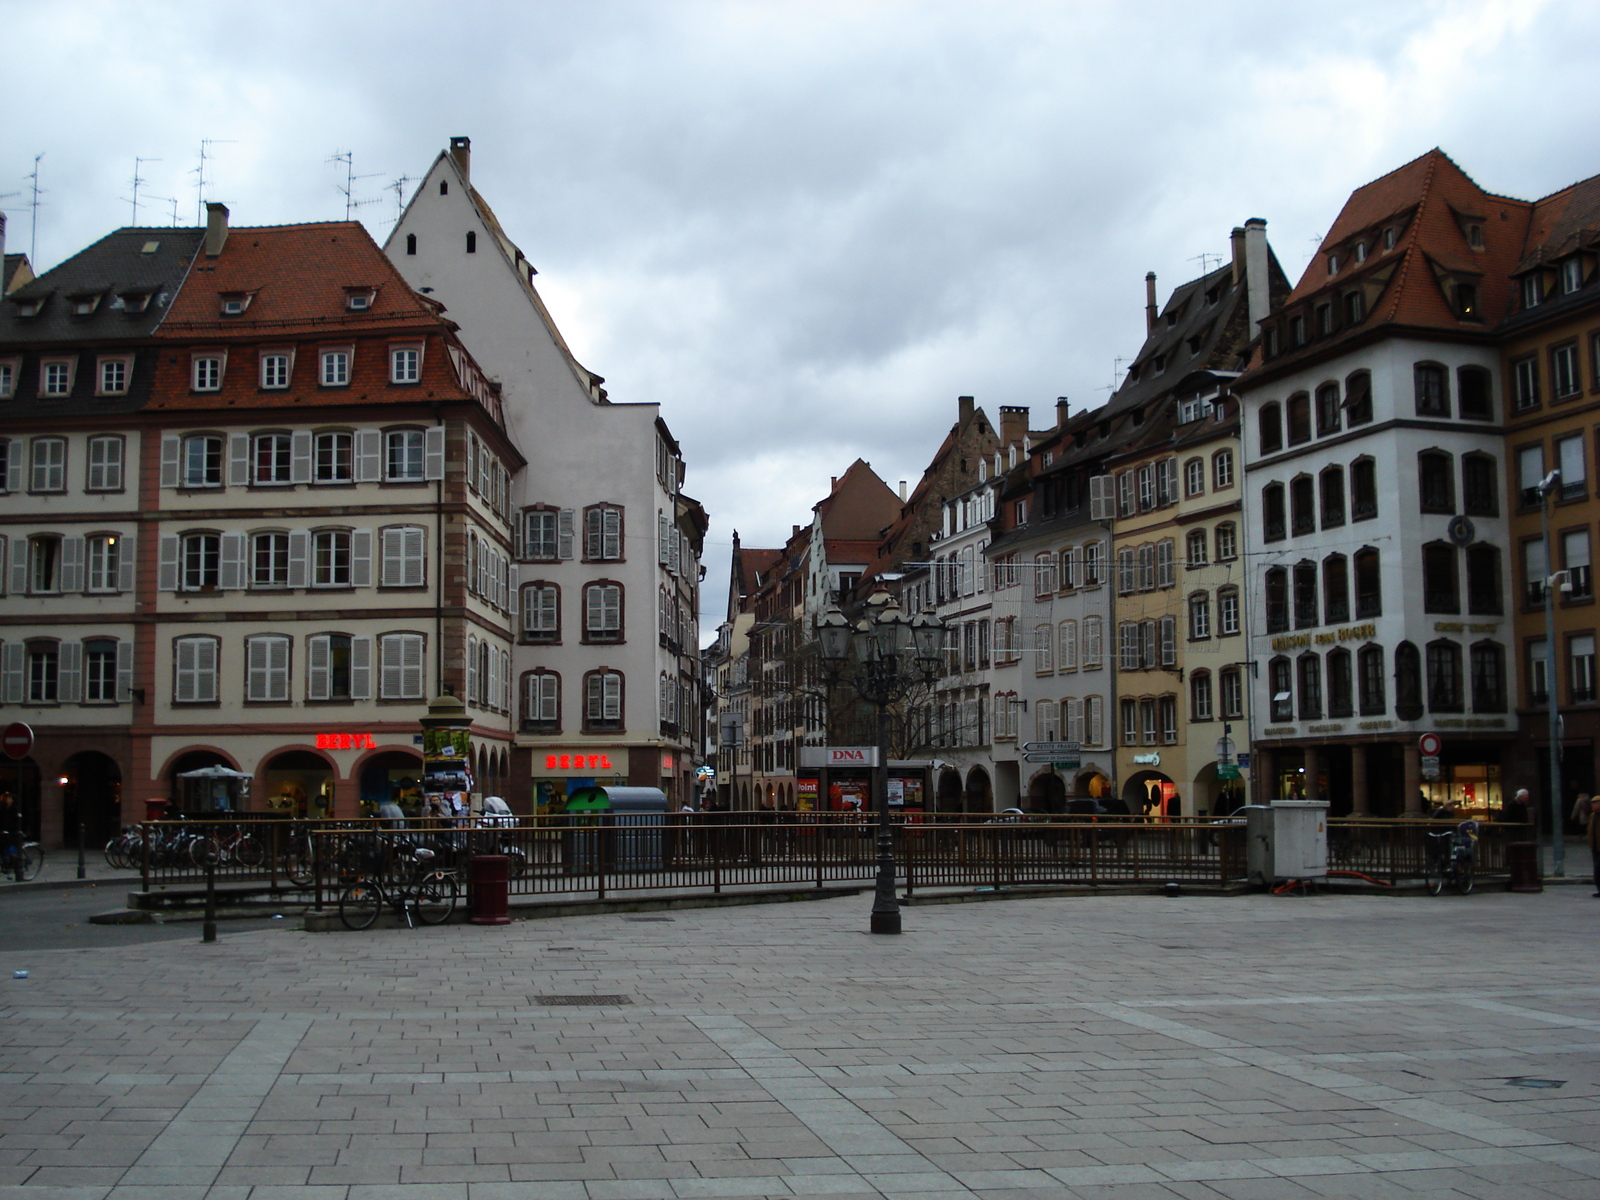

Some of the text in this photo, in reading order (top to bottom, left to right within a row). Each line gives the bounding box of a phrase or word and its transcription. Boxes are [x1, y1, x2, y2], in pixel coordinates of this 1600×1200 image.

[316, 733, 376, 749] BERYL
[545, 754, 612, 769] BERYL
[832, 750, 864, 760] DNA
